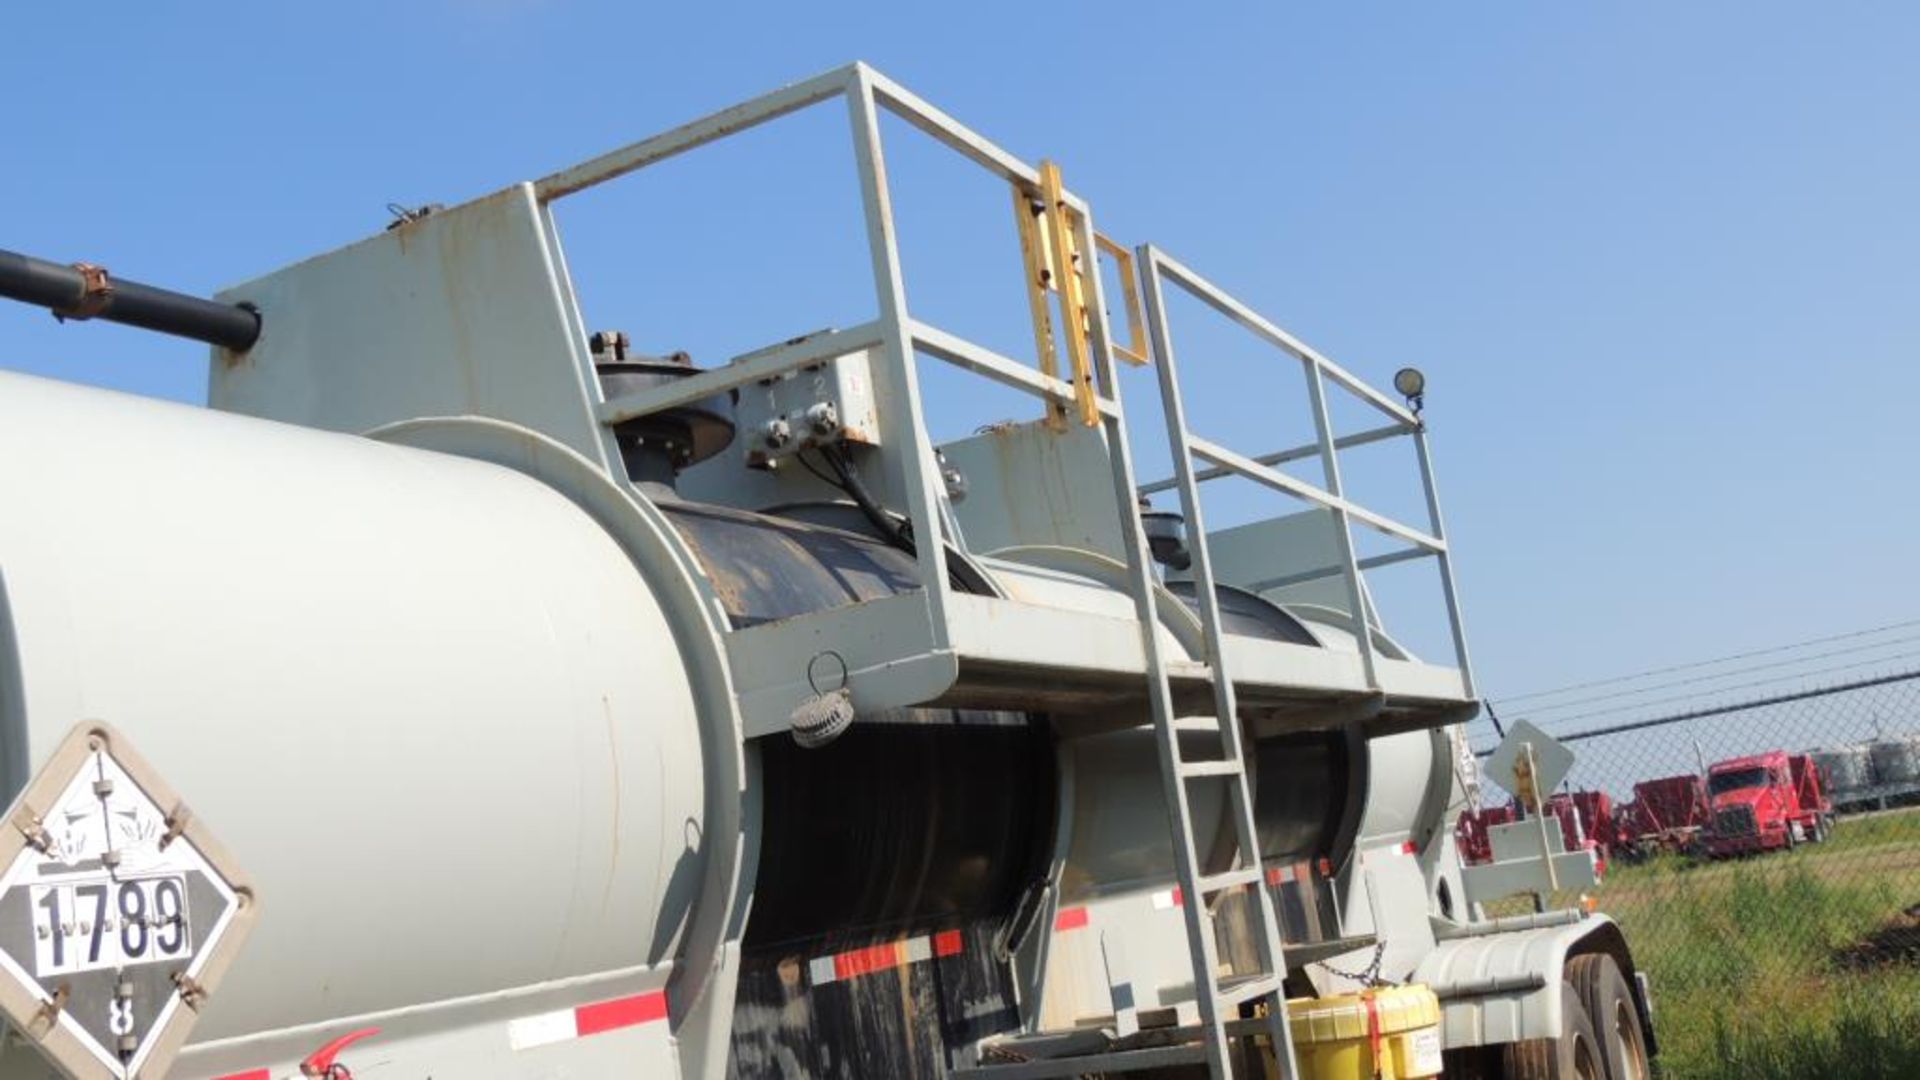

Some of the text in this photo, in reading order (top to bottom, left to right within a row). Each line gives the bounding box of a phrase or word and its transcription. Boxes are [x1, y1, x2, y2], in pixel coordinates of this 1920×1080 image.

[813, 376, 828, 395] 2
[38, 880, 184, 967] 1789
[109, 999, 134, 1036] 8
